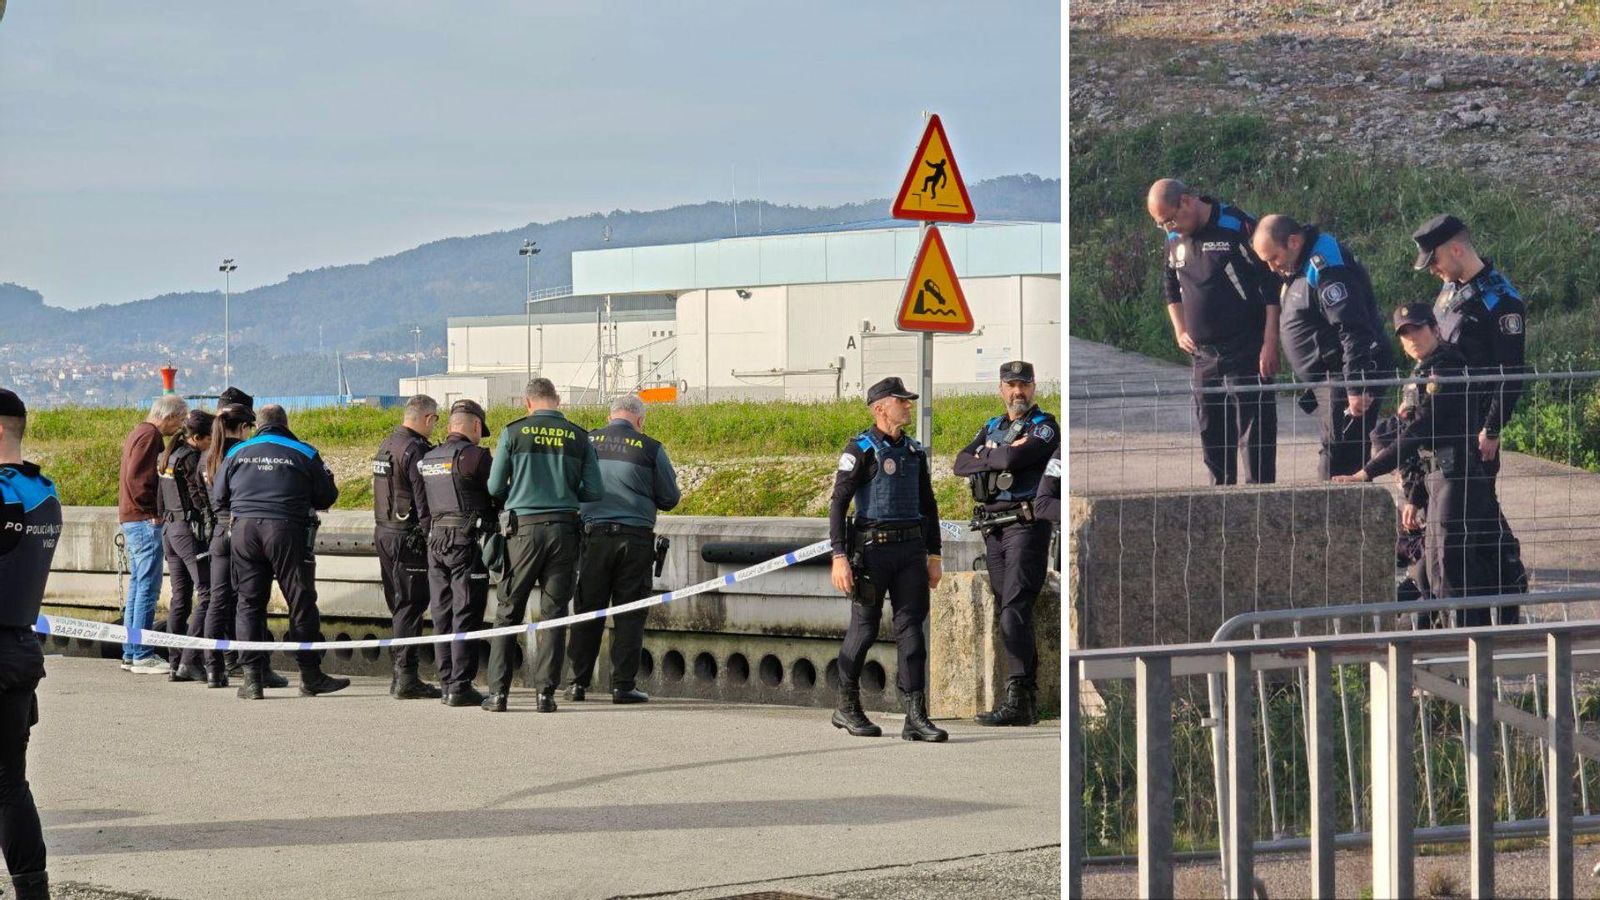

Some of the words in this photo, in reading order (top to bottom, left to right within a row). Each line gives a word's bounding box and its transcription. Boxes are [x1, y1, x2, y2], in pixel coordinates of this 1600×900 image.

[847, 336, 856, 349] A
[521, 426, 576, 441] GUARDIA
[534, 436, 564, 447] CIVIL
[268, 457, 294, 466] LOCAL
[4, 521, 23, 532] PO
[42, 539, 56, 549] VIGO
